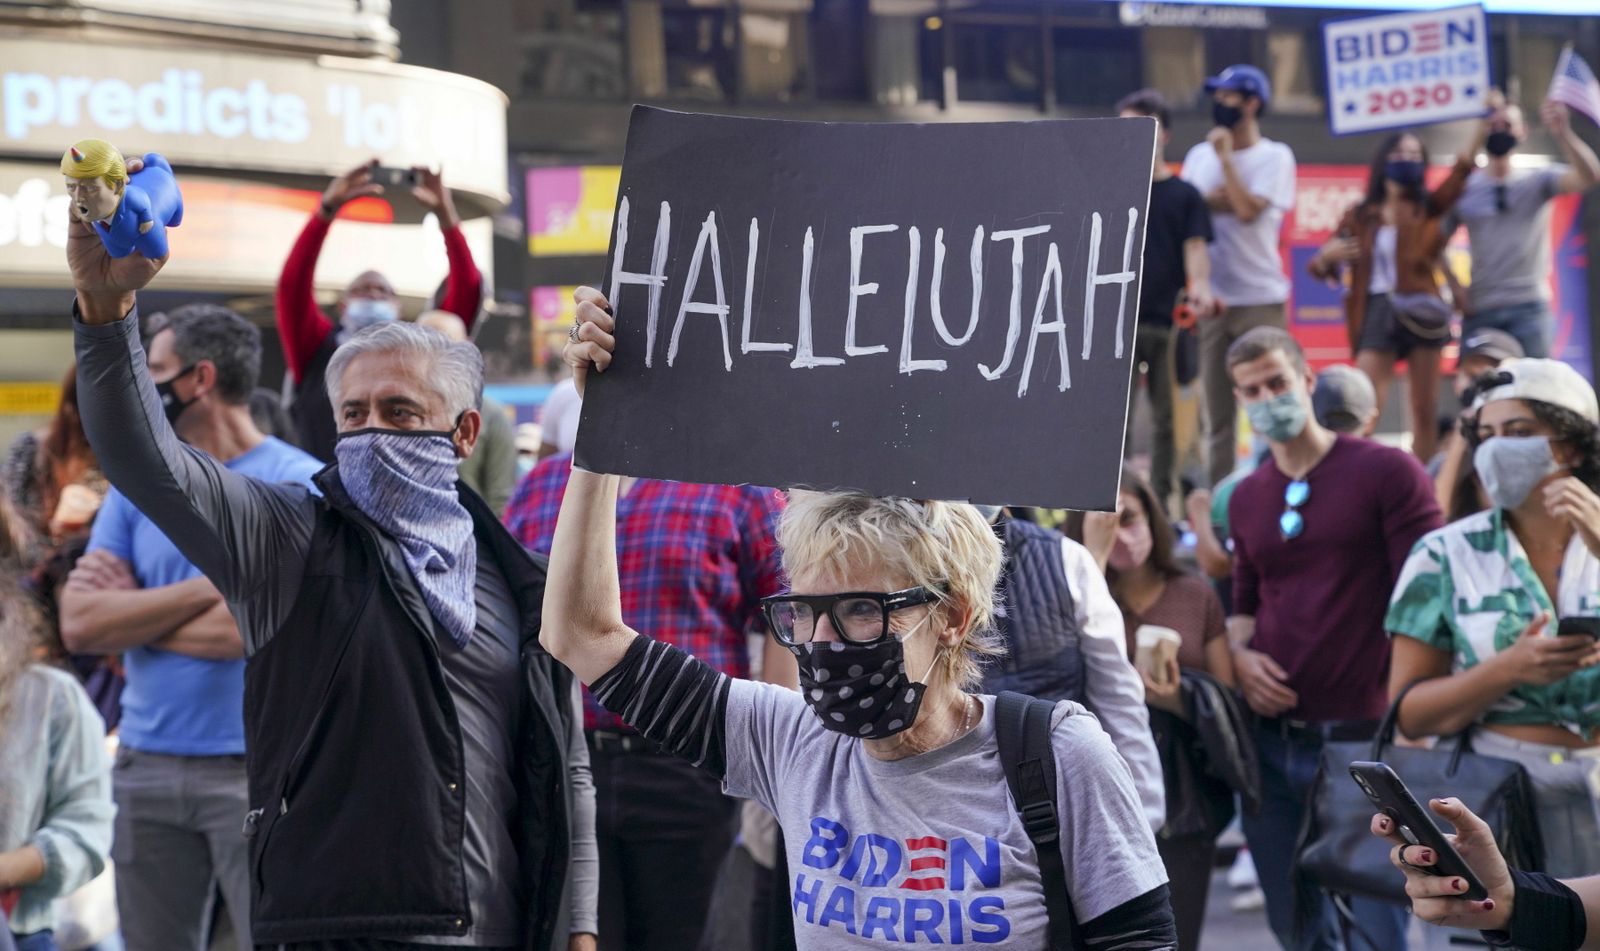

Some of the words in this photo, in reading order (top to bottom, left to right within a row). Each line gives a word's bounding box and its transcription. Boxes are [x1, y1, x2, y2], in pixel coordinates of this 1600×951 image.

[1335, 17, 1476, 64] BIDEN
[1337, 51, 1480, 91] HARRIS
[3, 67, 311, 144] predicts
[1367, 82, 1453, 116] 2020
[609, 195, 1138, 397] HALLELUJAH
[802, 816, 1002, 892] BIDEN
[793, 873, 1011, 945] HARRIS
